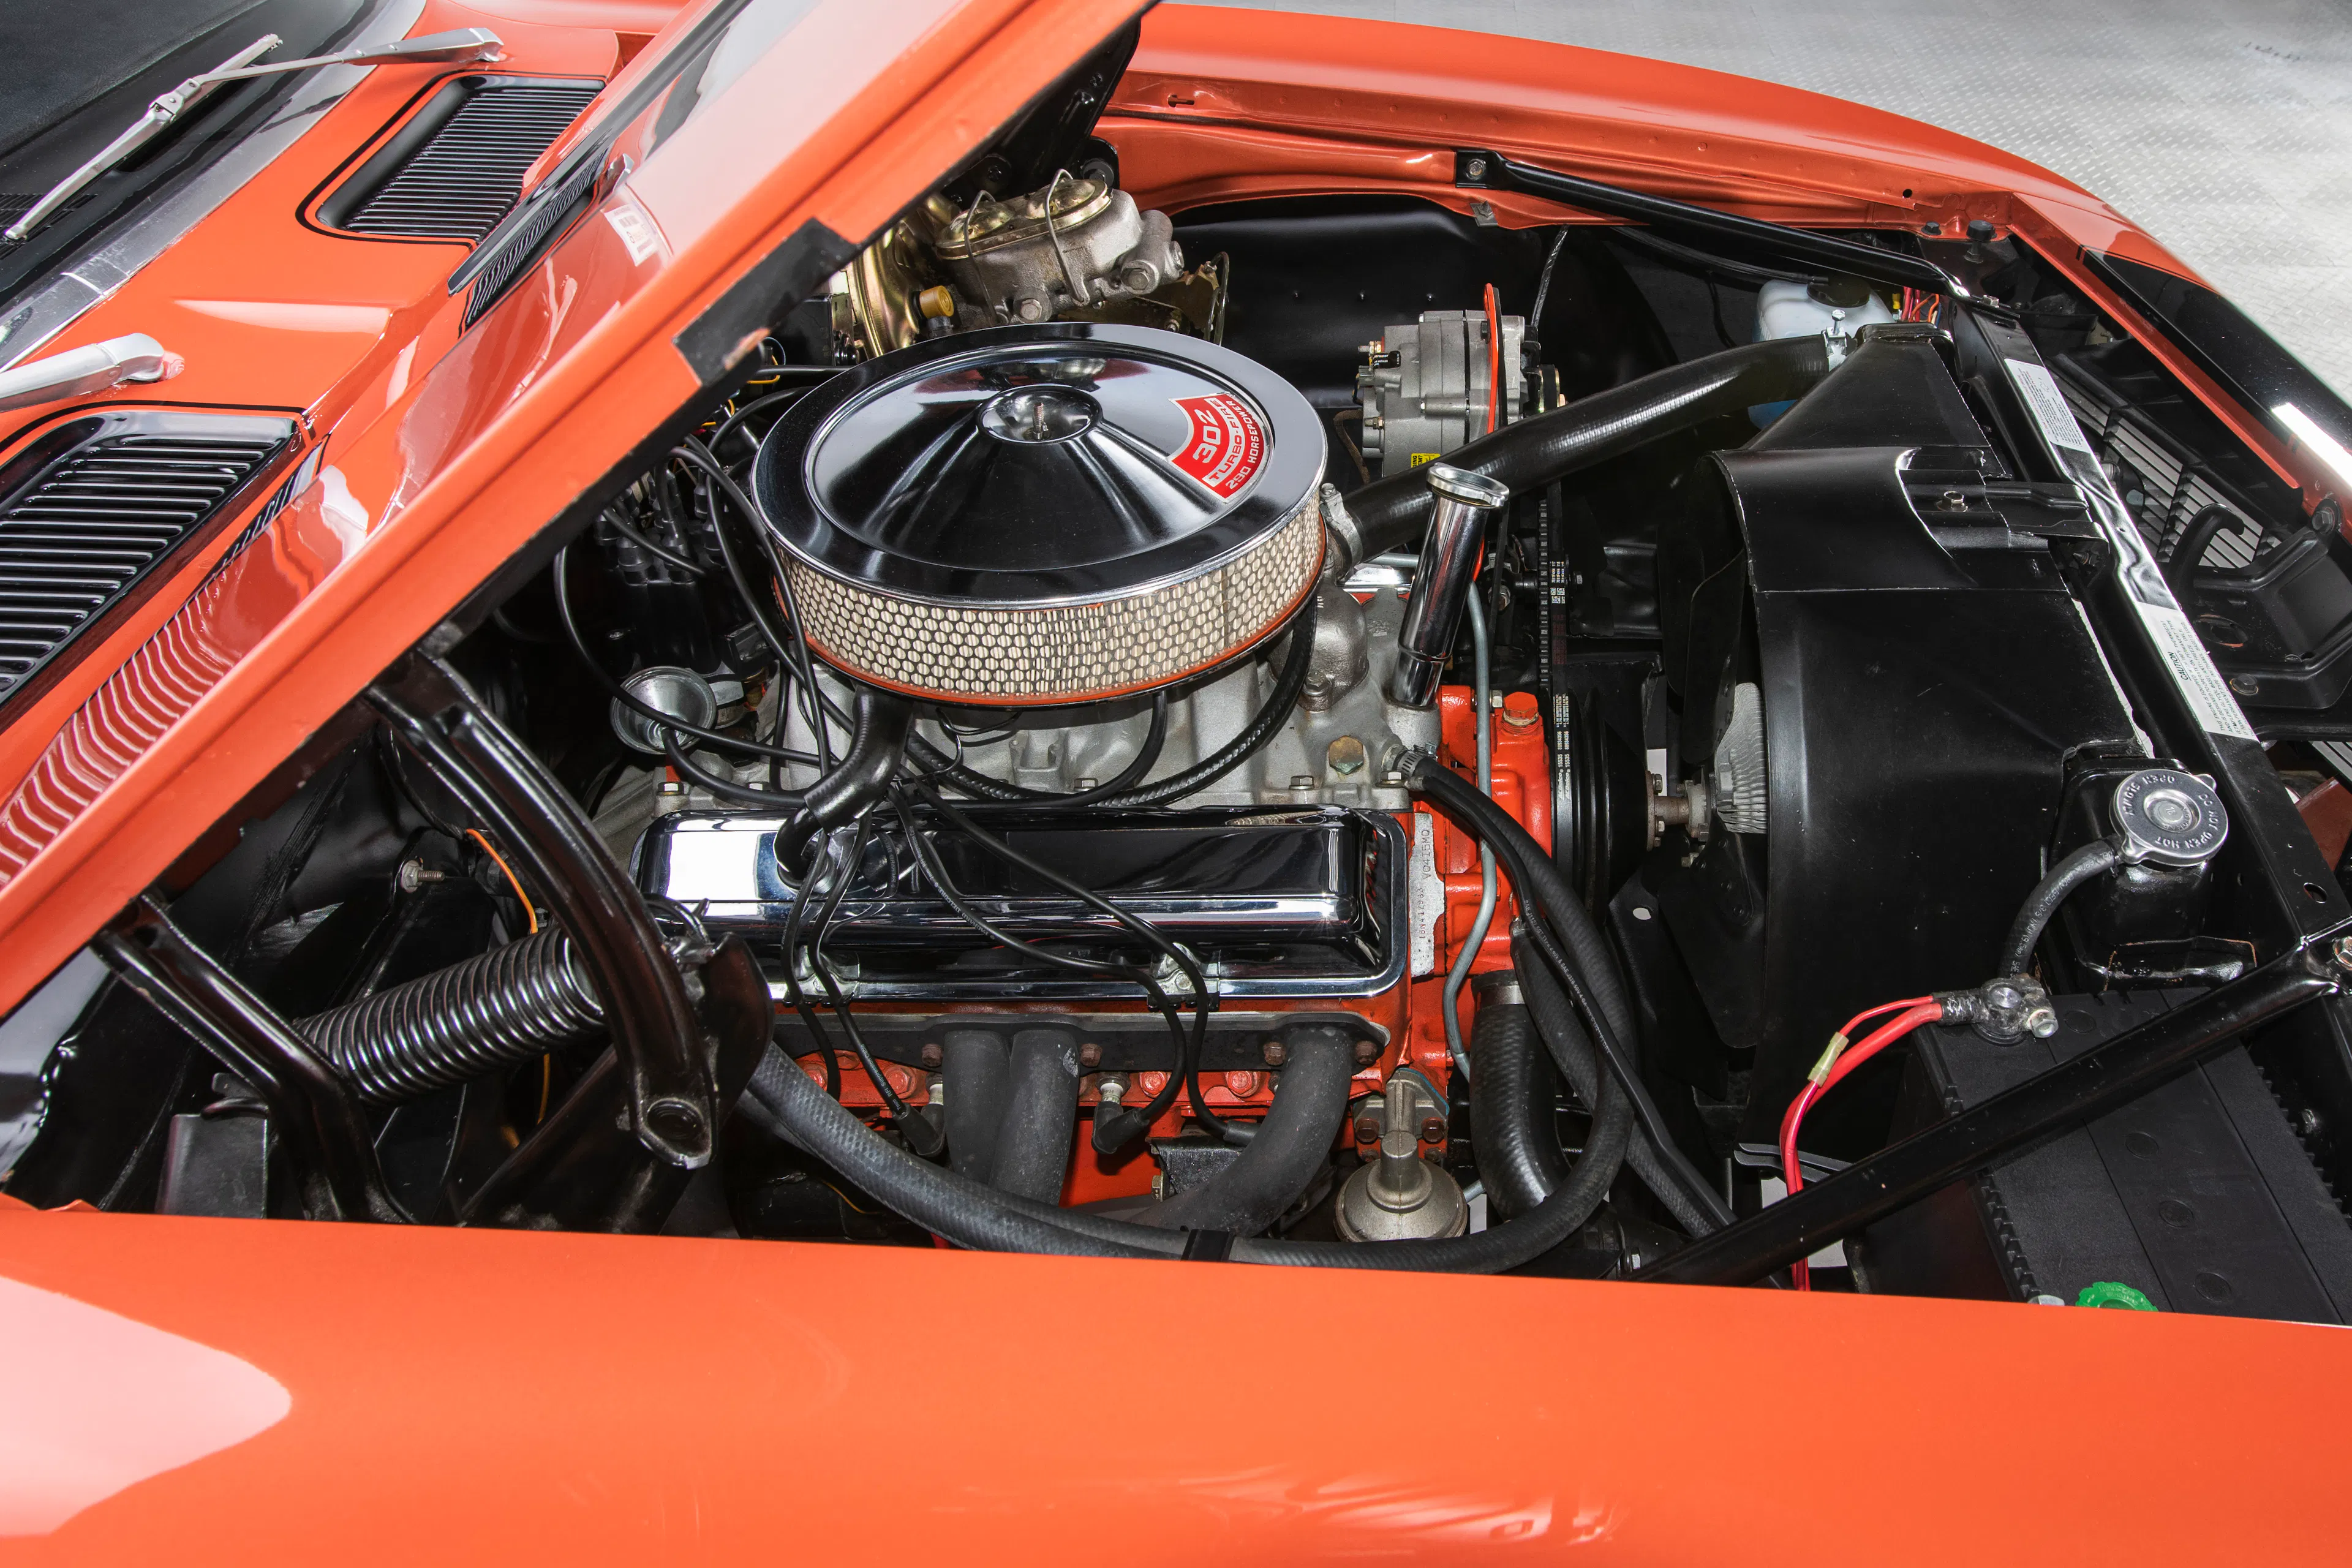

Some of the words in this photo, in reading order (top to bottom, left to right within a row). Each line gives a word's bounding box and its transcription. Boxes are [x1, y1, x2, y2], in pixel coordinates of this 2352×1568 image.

[1193, 409, 1221, 463] 302
[1208, 399, 1242, 481] TURBO-FIRE
[1226, 401, 1259, 464] HORSEPOWER
[1226, 466, 1251, 489] 290
[2161, 621, 2177, 647] THERMOSTAT
[2166, 620, 2176, 630] TYPE
[2173, 633, 2190, 658] PERMANENT
[2169, 652, 2188, 680] CAUTION
[2194, 667, 2207, 686] OPERATE
[2191, 674, 2206, 696] EQUIPPED
[2206, 702, 2219, 719] ENGINE
[2208, 693, 2224, 716] DESIGNED
[2217, 720, 2225, 731] THIS
[2225, 722, 2233, 733] AND
[2142, 774, 2175, 785] OPEN
[2122, 782, 2141, 816] SLOWLY
[2198, 793, 2213, 807] DO
[2165, 807, 2176, 815] 16
[2209, 810, 2218, 831] NOT
[2155, 836, 2180, 849] HOT
[2184, 831, 2212, 849] OPEN
[961, 913, 989, 935] PACKARD
[1581, 998, 1587, 1006] GA
[860, 1044, 869, 1058] Cable
[867, 1058, 884, 1087] Suppression
